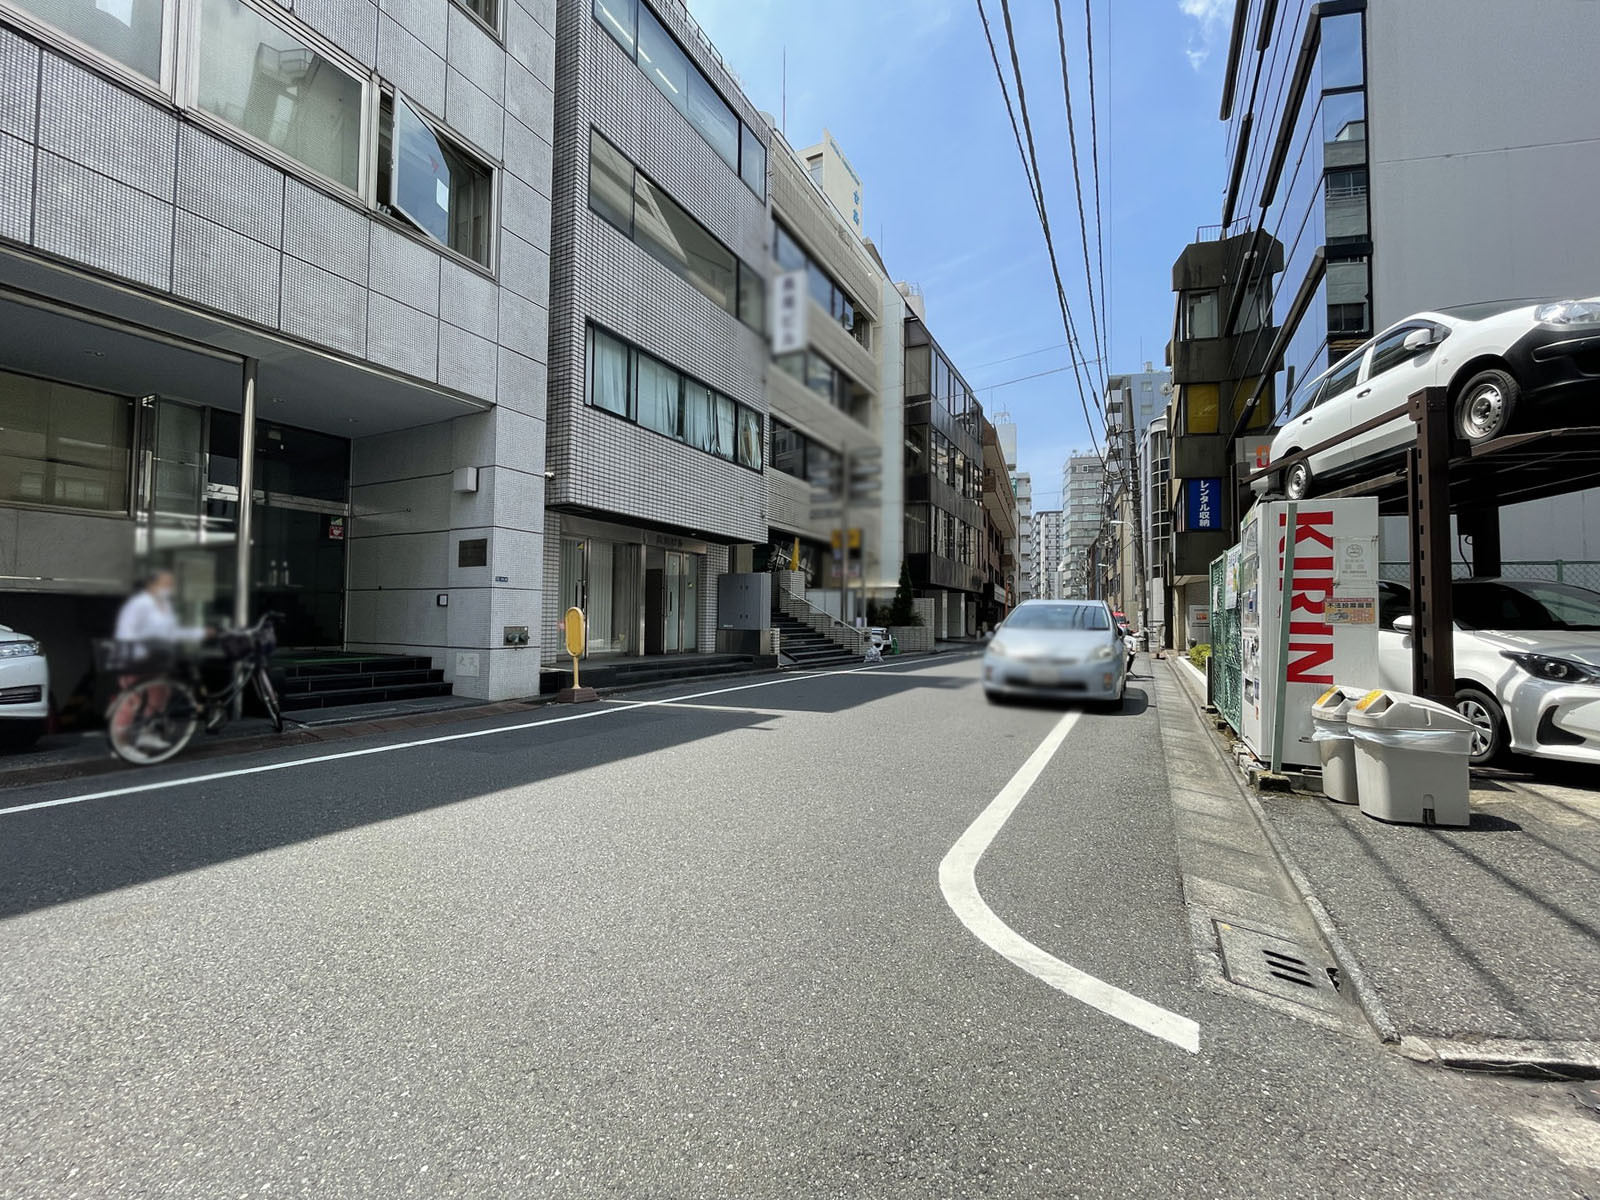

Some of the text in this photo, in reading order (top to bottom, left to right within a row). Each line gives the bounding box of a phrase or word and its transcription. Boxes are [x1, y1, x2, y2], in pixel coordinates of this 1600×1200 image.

[1199, 480, 1210, 527] レンタル収納
[1278, 511, 1334, 684] KIRIN
